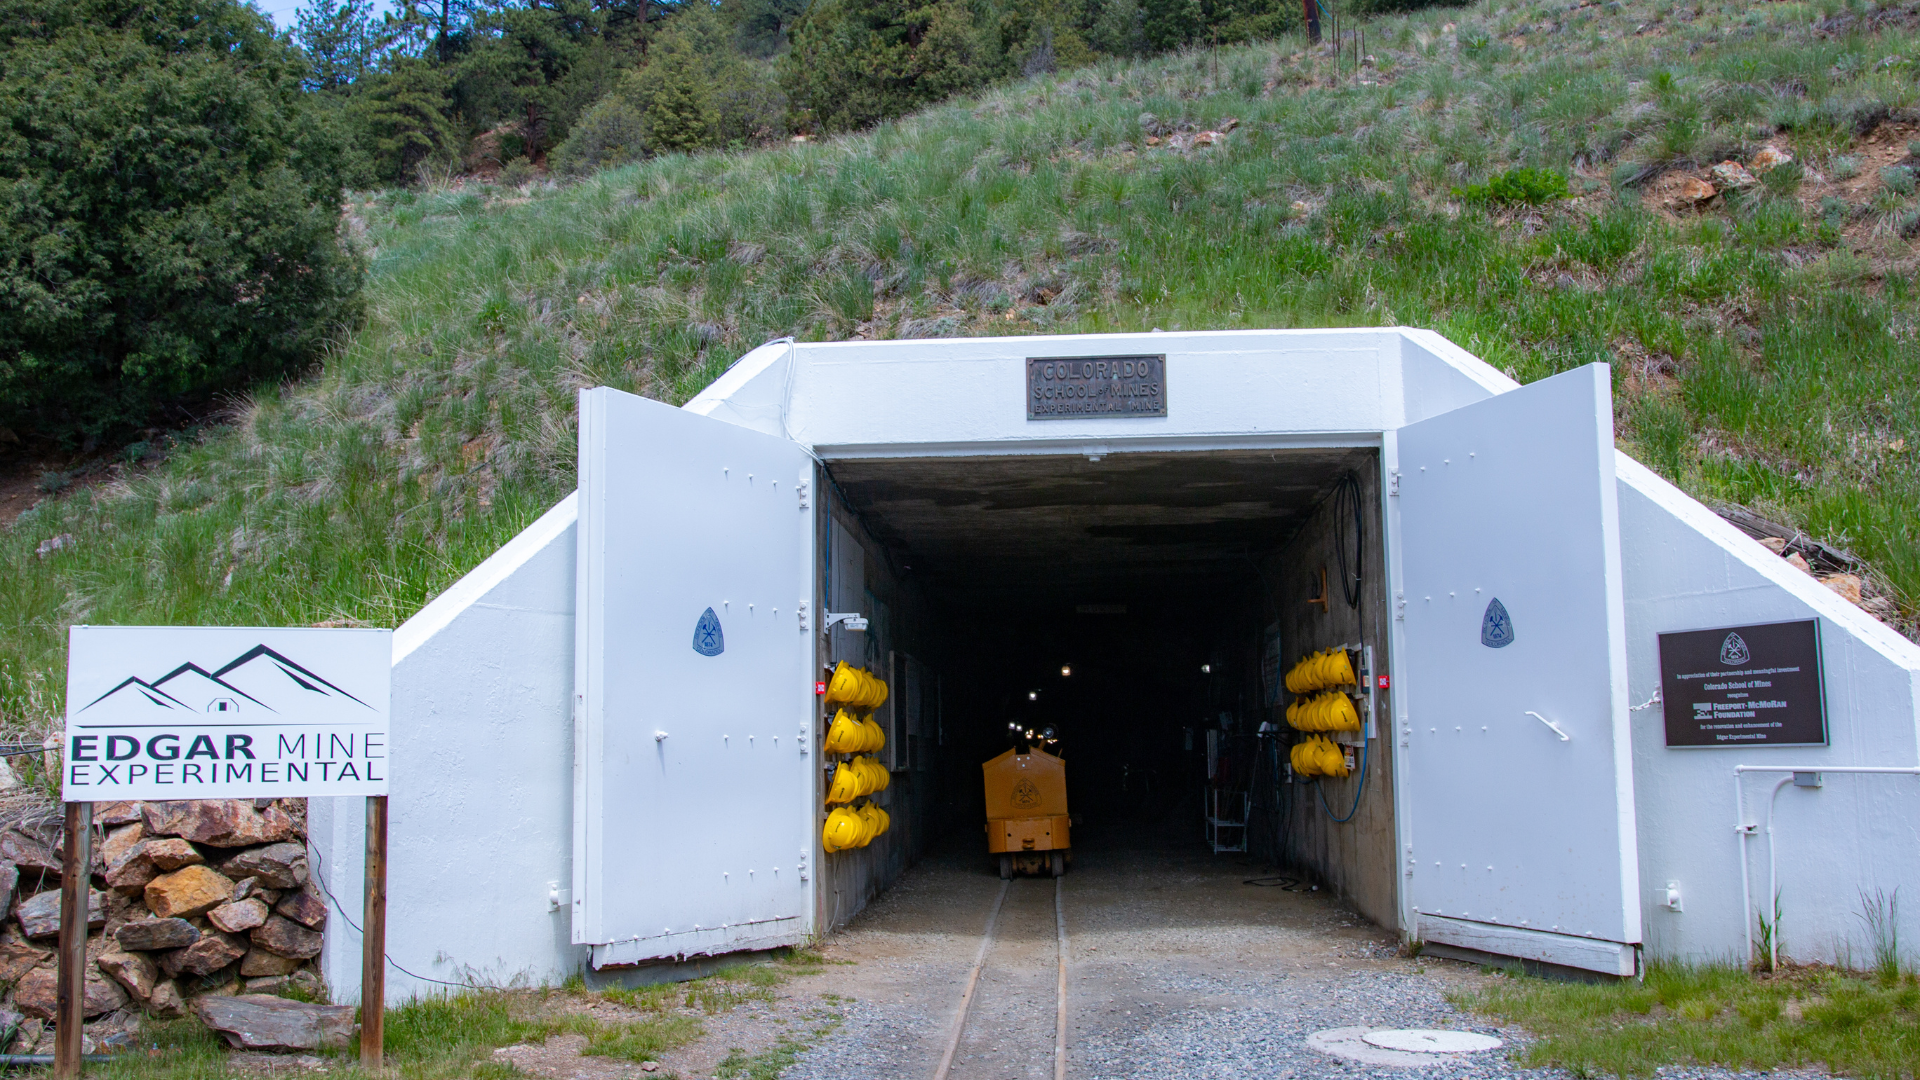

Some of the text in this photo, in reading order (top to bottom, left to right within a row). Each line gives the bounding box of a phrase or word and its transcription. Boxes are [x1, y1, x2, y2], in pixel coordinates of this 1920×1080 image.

[1042, 360, 1149, 380] COLORADO
[1034, 382, 1159, 399] SCHOOL OF MINES
[1034, 400, 1159, 414] EXPERIMENTAL MINE
[1704, 682, 1727, 690] Colorado
[1728, 681, 1747, 689] School
[70, 732, 385, 762] EDGAR MINE
[70, 761, 384, 786] EXPERIMENTAL
